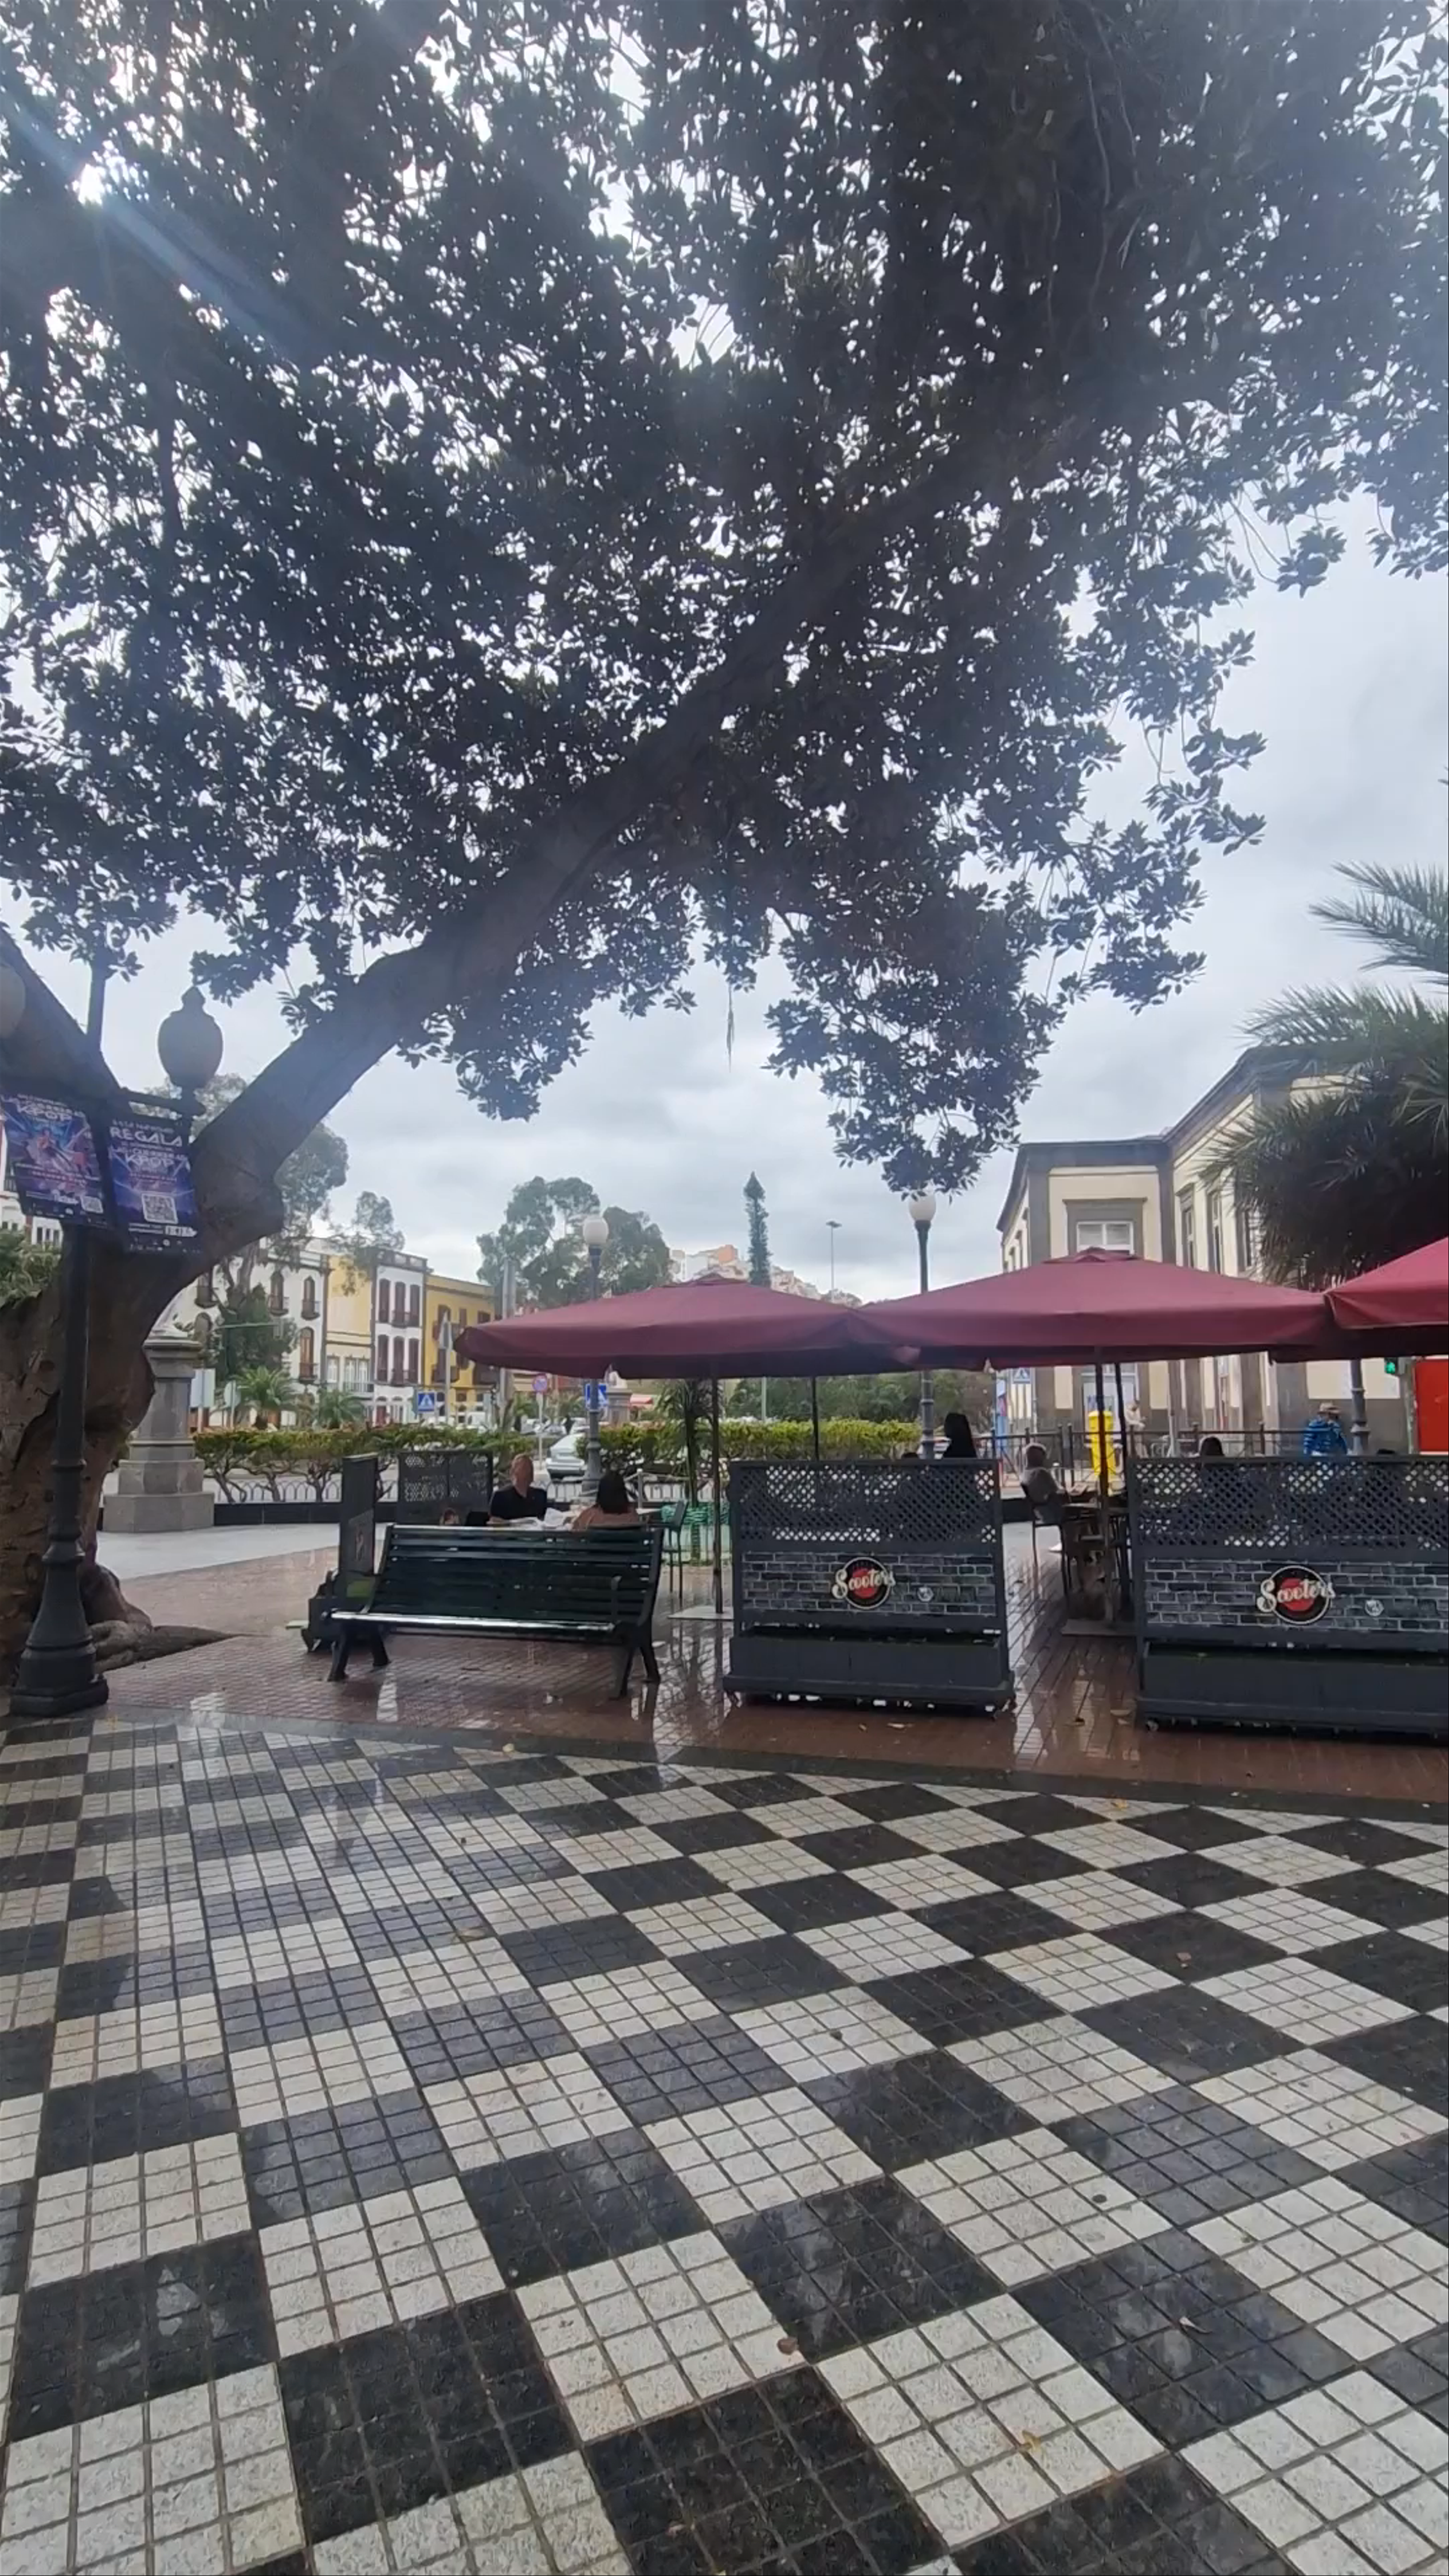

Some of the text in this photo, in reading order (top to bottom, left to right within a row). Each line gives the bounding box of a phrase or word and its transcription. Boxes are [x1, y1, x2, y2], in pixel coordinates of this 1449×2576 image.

[110, 1126, 183, 1147] REGALA
[125, 1153, 174, 1167] KPOP
[832, 1569, 896, 1599] Scooters
[1257, 1579, 1336, 1613] Scooters
